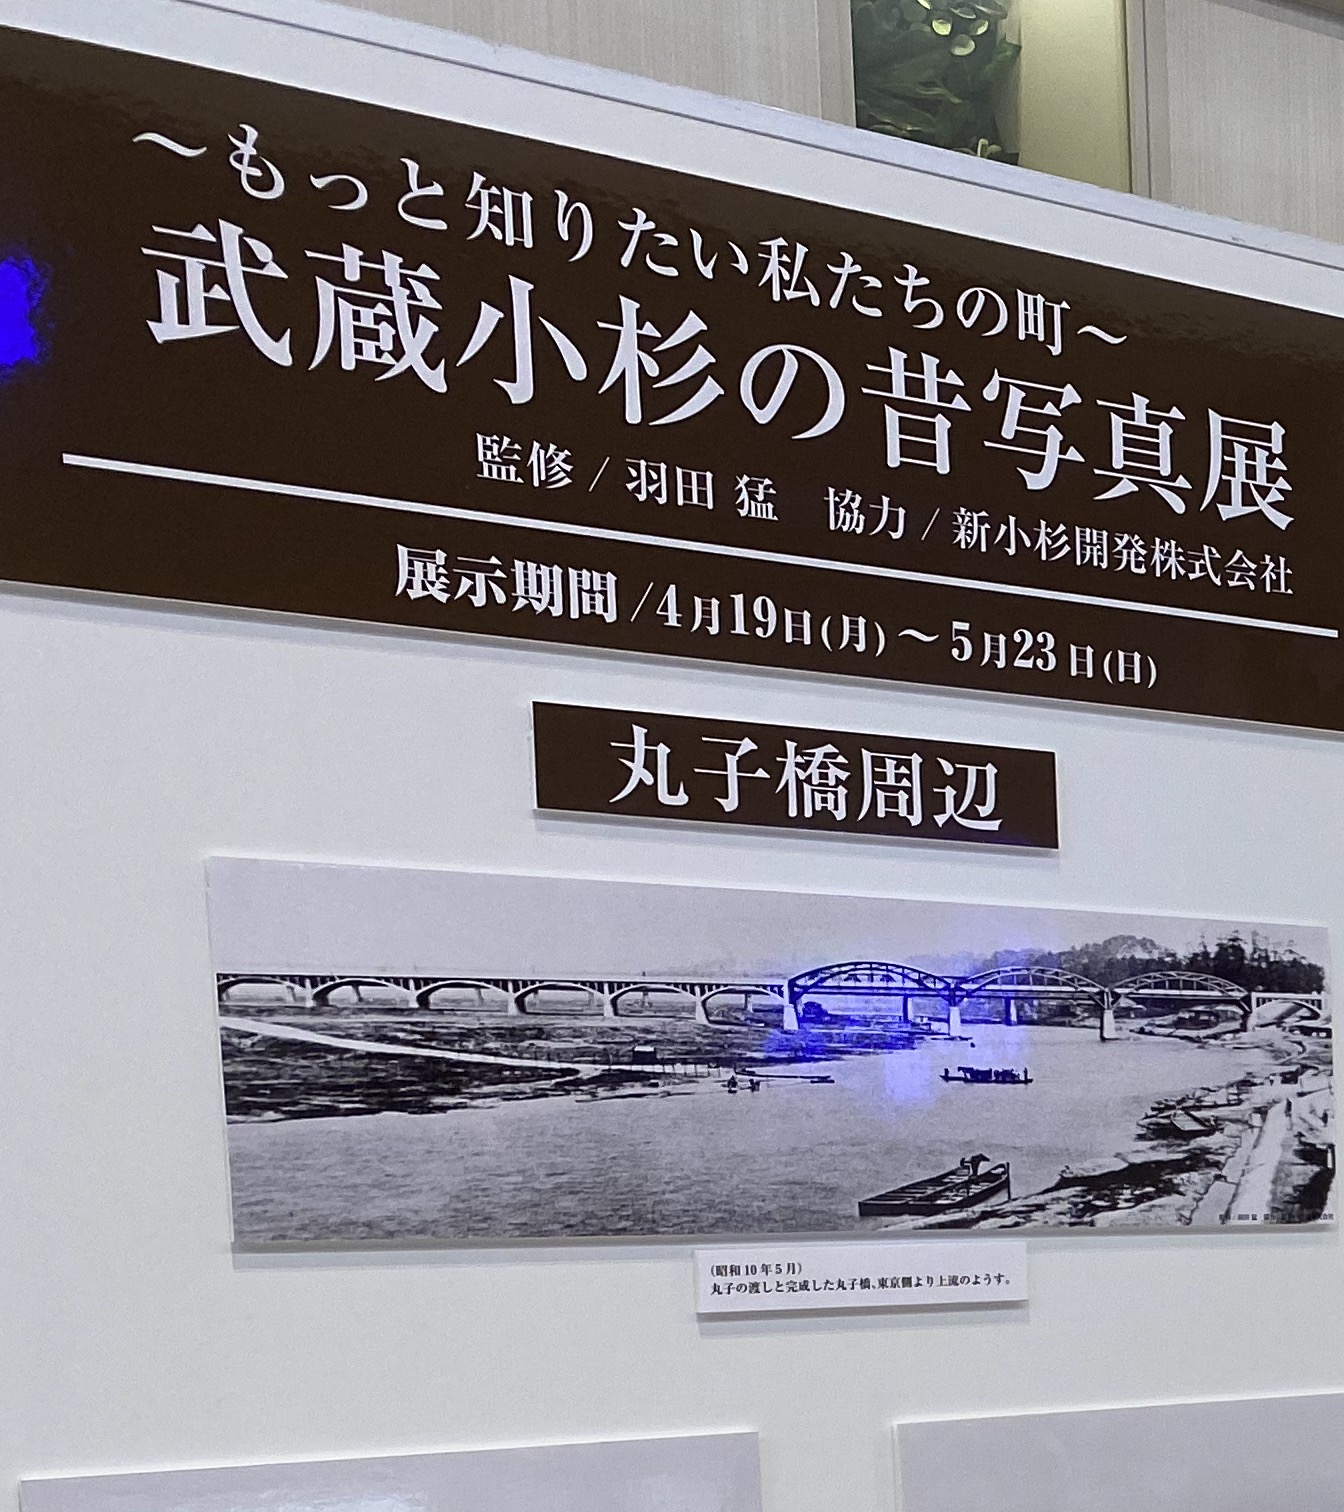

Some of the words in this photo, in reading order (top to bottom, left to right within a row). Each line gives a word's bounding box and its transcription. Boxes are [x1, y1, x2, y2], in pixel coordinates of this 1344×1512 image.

[142, 220, 1294, 531] 武蔵小杉の昔写真展
[735, 475, 779, 524] 猛
[609, 726, 1004, 832] 丸子橋周辺
